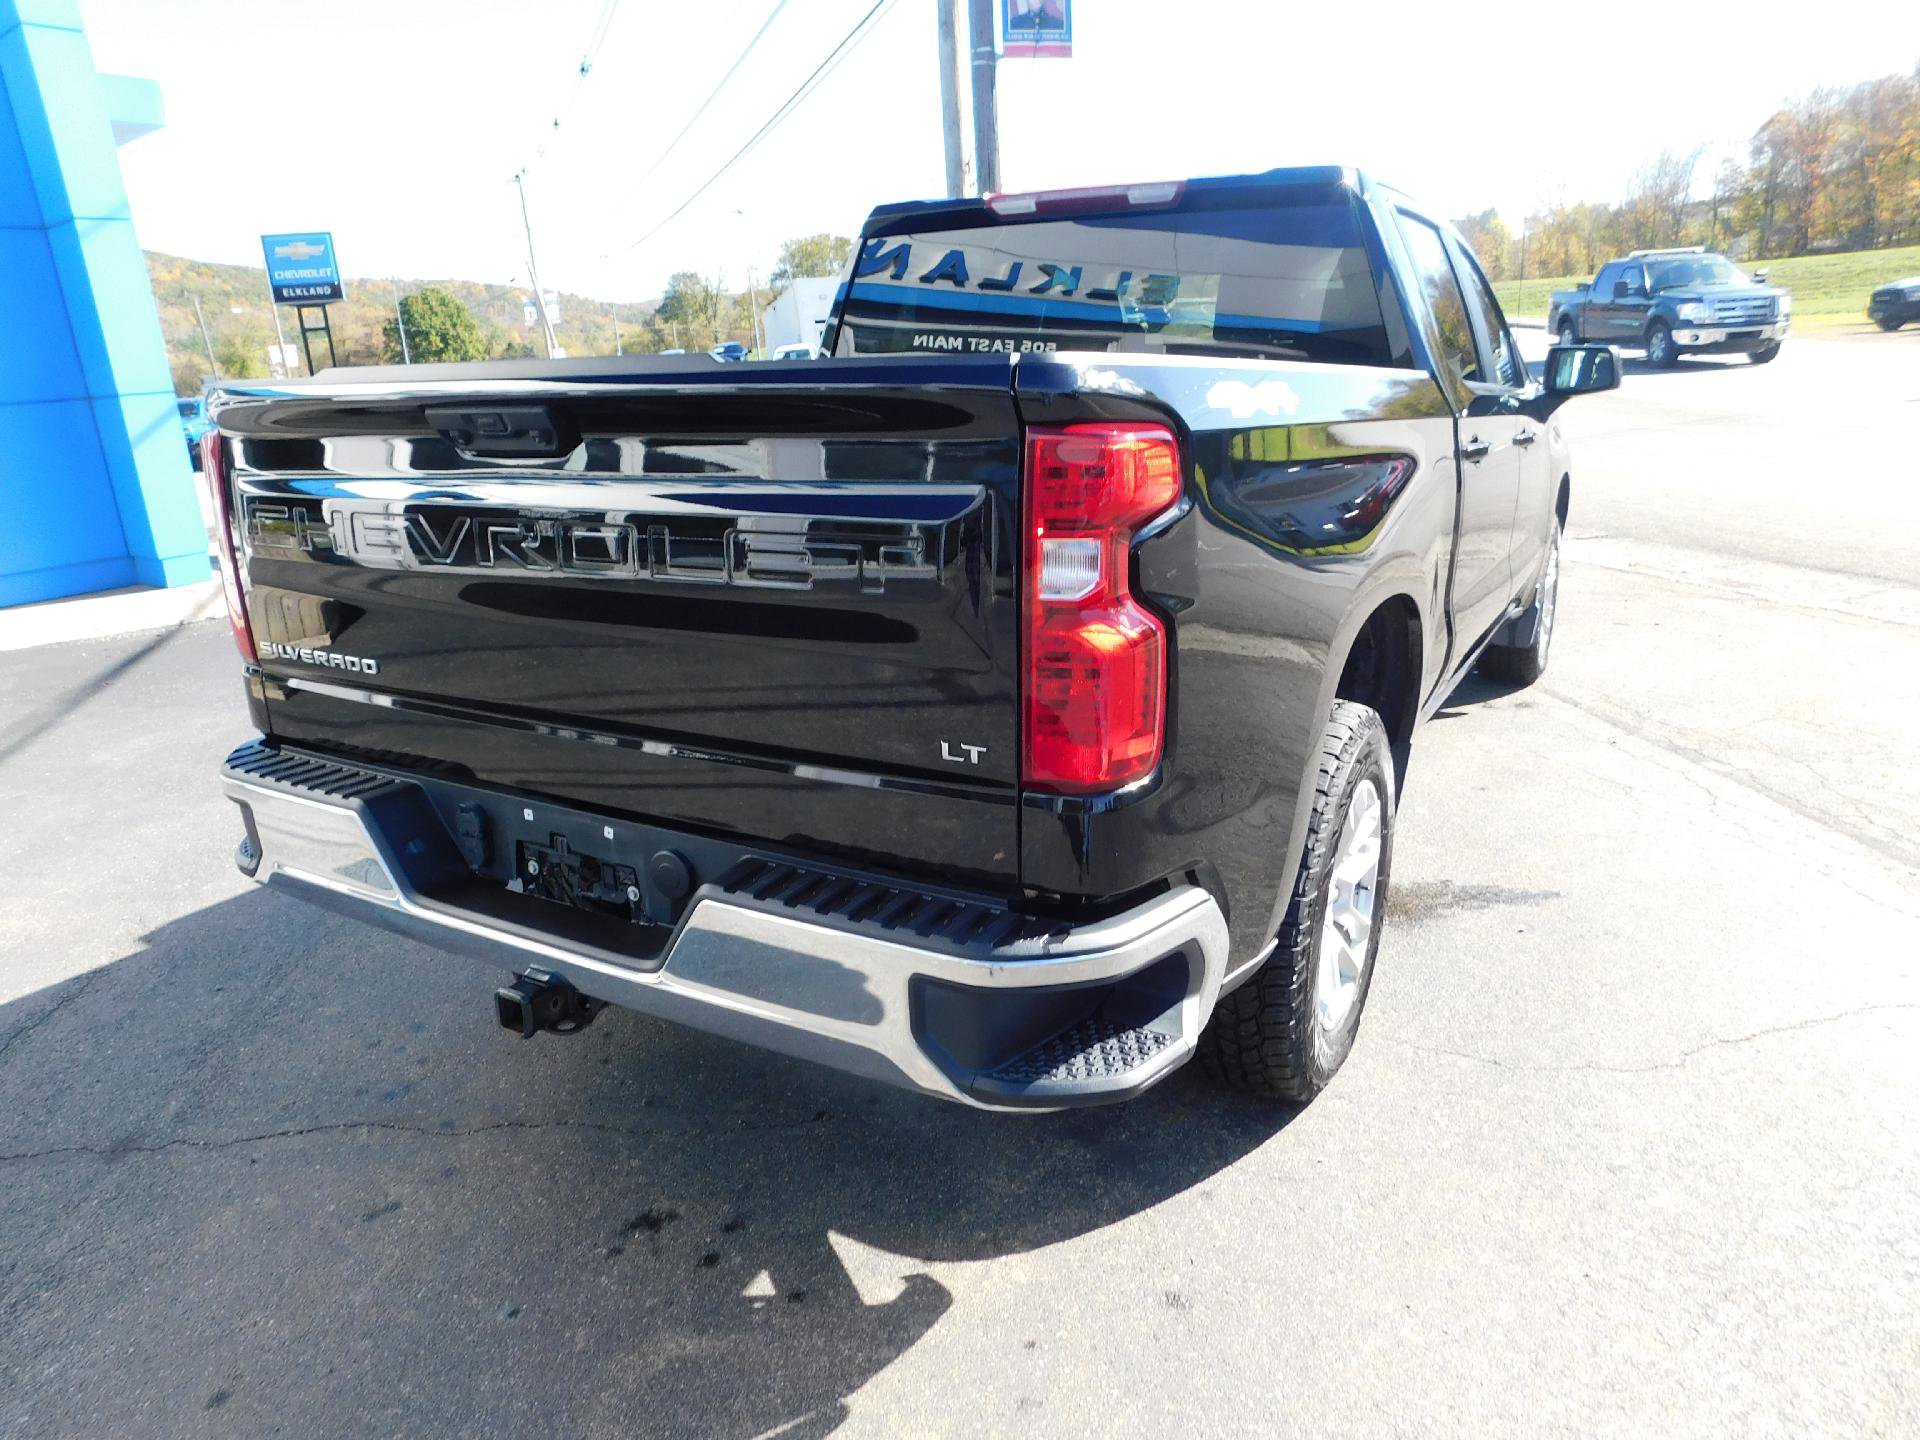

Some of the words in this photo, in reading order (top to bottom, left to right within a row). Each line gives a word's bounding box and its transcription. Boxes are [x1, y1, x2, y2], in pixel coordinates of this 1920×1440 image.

[275, 268, 332, 280] CHEVROLET
[283, 286, 332, 298] ELKLAND
[249, 502, 926, 594] CHEVROLET
[259, 640, 379, 675] SILVERADO
[940, 739, 987, 765] LT
